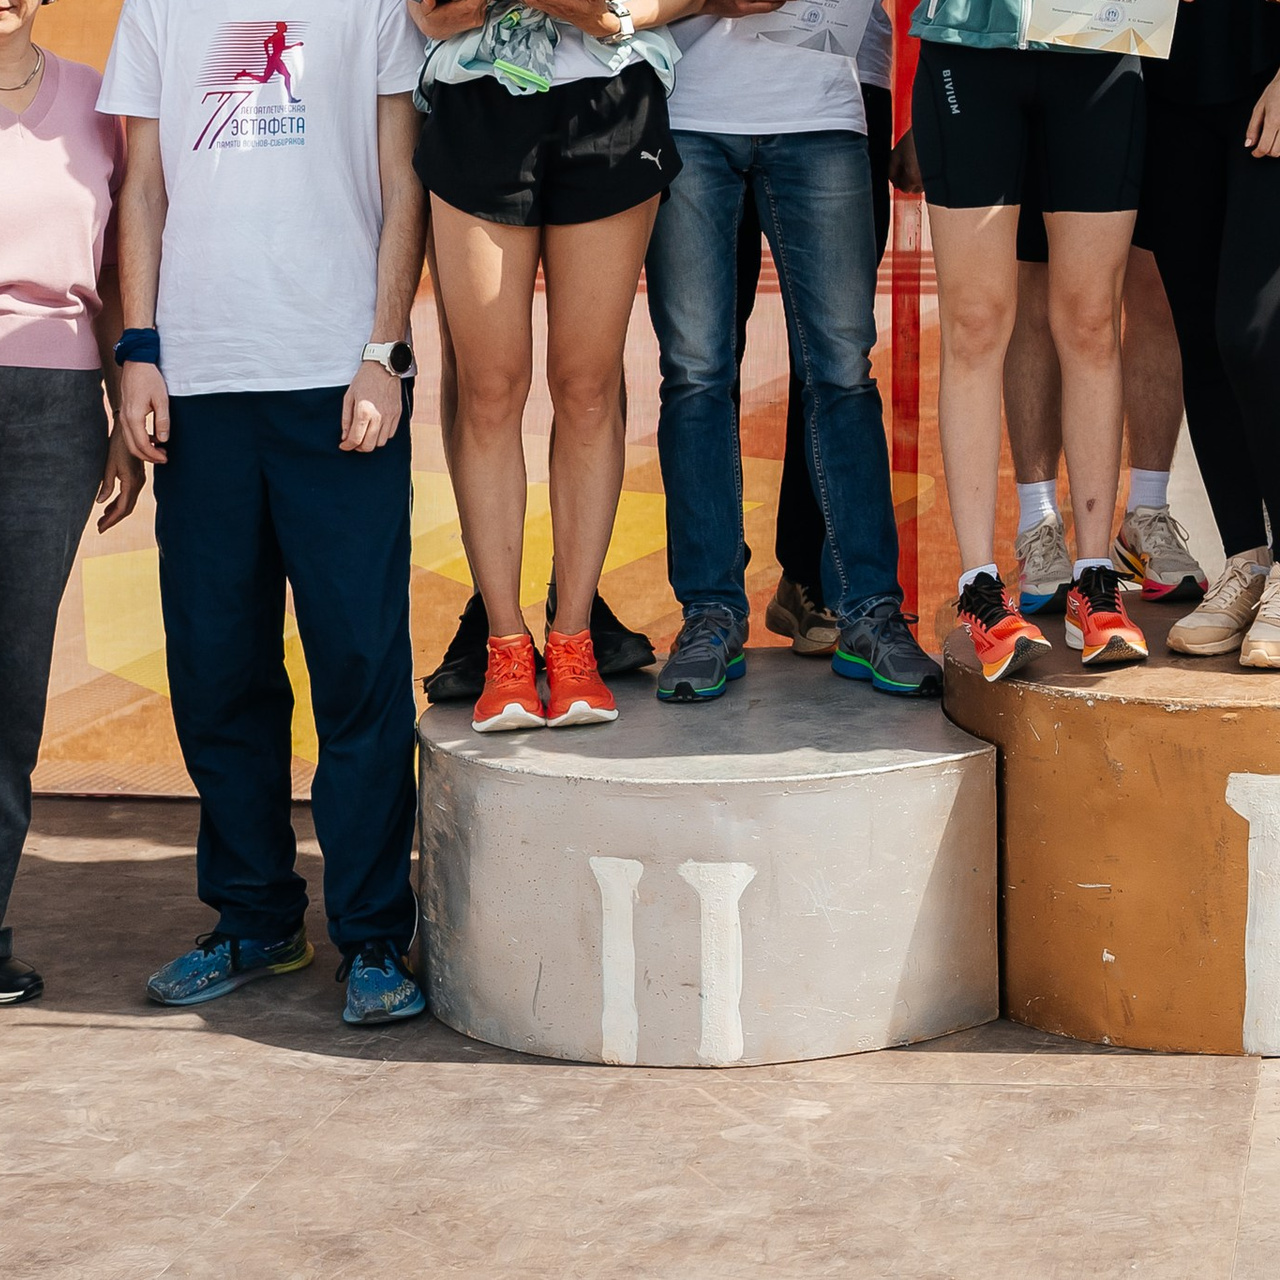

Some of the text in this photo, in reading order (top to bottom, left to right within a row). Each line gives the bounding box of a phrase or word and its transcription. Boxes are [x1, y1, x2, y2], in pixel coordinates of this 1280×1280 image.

[942, 69, 960, 115] BIVIUM
[193, 90, 253, 151] 77
[231, 116, 305, 137] ЭСТАФЕТА
[216, 140, 241, 149] ПАМЯТИ
[589, 857, 757, 1065] II
